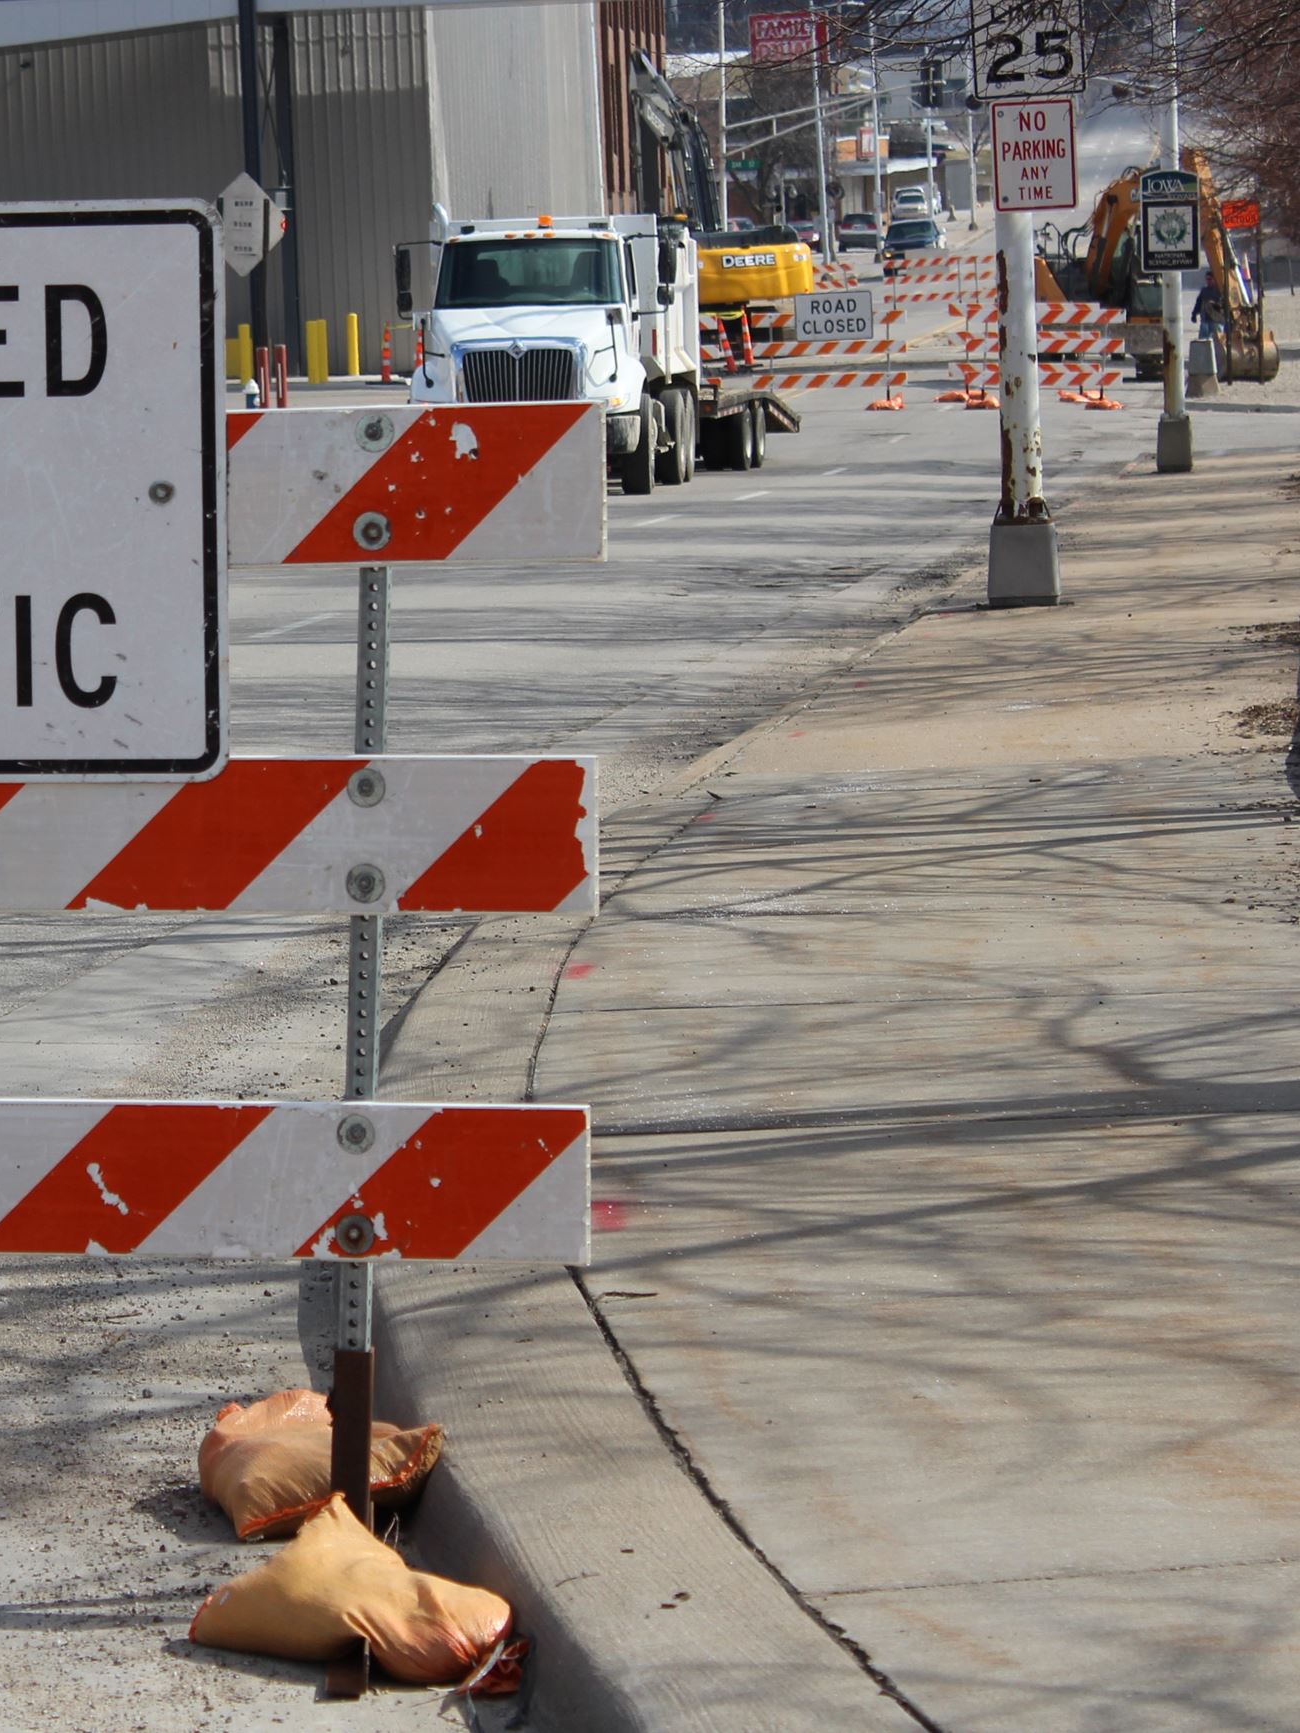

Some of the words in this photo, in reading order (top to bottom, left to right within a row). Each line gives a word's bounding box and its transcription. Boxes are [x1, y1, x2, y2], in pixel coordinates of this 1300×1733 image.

[986, 31, 1073, 82] 25
[1019, 110, 1046, 132] NO
[1002, 138, 1066, 162] PARKING
[1020, 166, 1049, 181] ANY
[1018, 186, 1053, 201] TIME
[1147, 179, 1185, 193] IOWA
[722, 254, 776, 268] DEERE
[810, 298, 857, 314] ROAD
[802, 318, 866, 335] CLOSED
